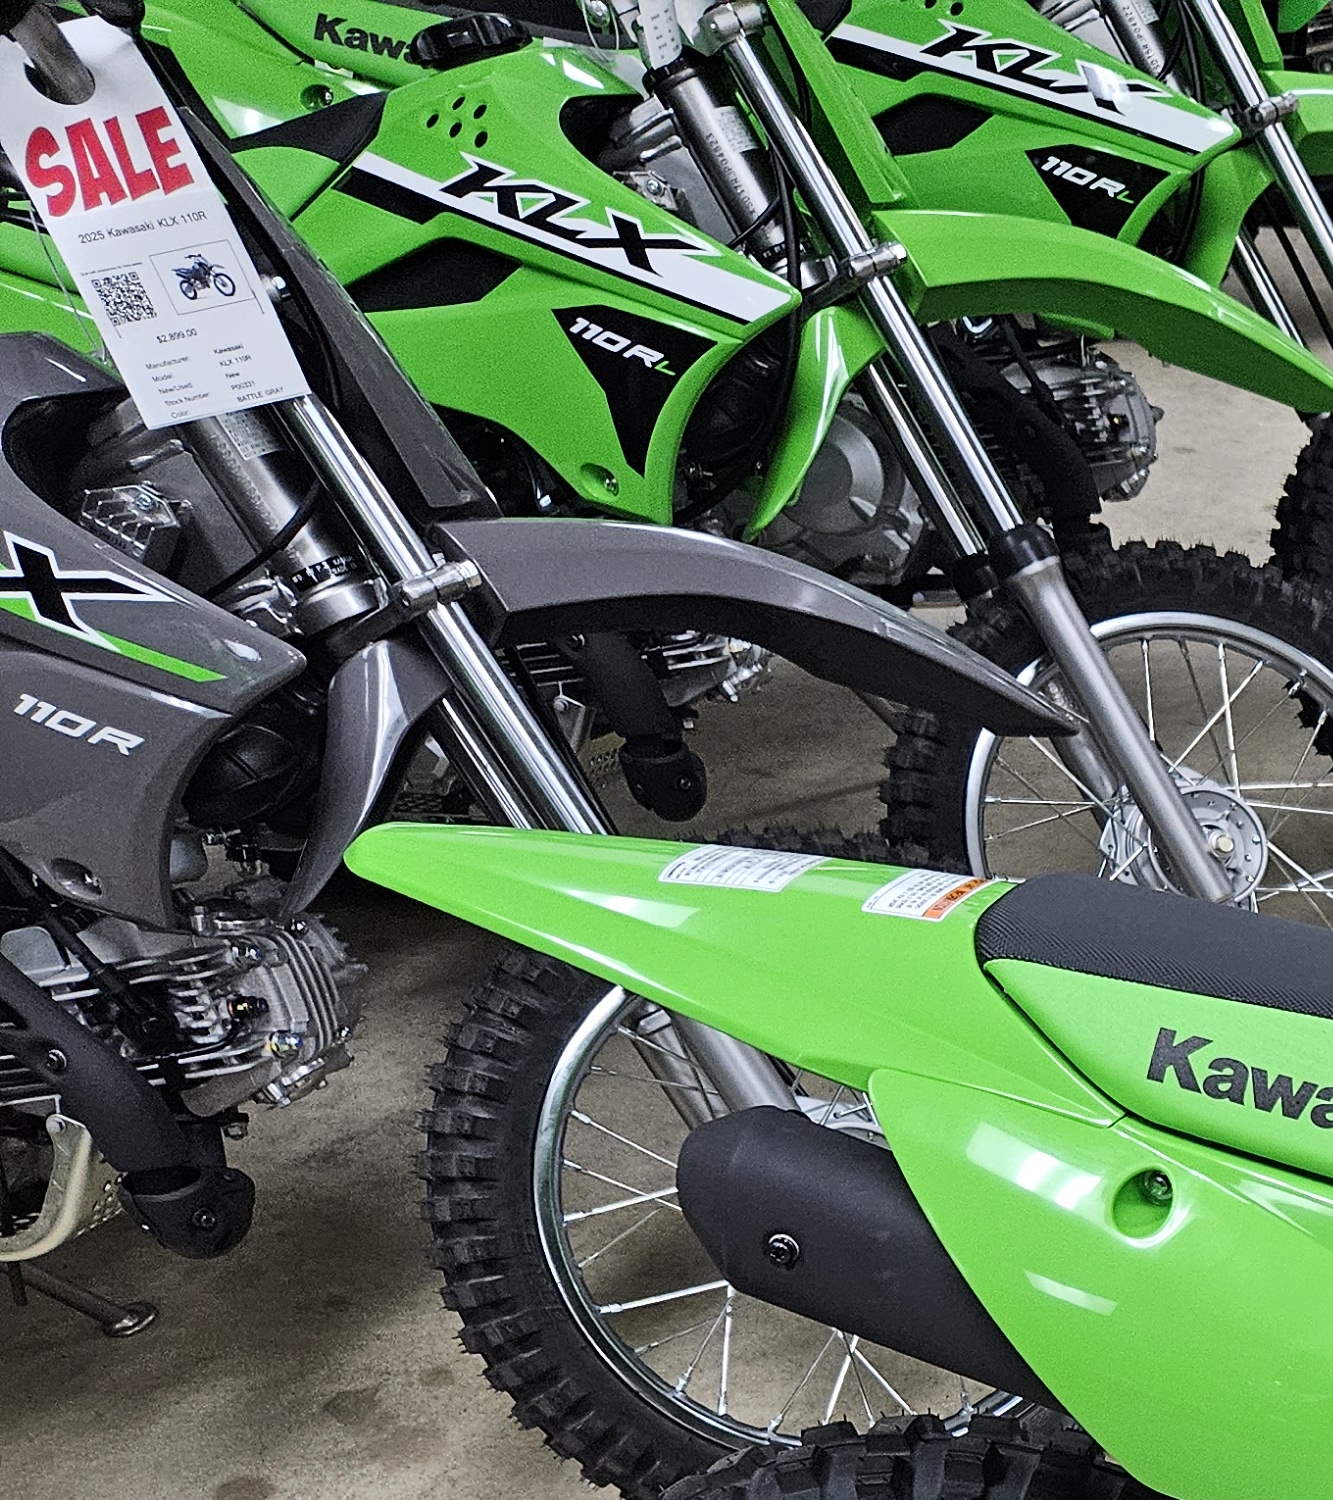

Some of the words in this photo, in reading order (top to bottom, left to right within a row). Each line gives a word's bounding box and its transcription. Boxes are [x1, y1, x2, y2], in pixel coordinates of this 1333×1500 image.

[918, 24, 1166, 117] KLX
[25, 106, 195, 217] SALE
[78, 230, 105, 244] 2025
[108, 221, 155, 238] Kawasaki
[157, 215, 178, 228] KLX
[180, 211, 207, 223] 110R
[437, 158, 713, 279] KLX
[213, 342, 244, 355] Kawasaki
[219, 358, 234, 367] KLX
[235, 354, 252, 364] 110R
[225, 372, 240, 380] New
[165, 398, 183, 408] Stock
[237, 391, 263, 403] BATTLE
[264, 386, 285, 397] GRAY
[13, 693, 146, 756] 110R
